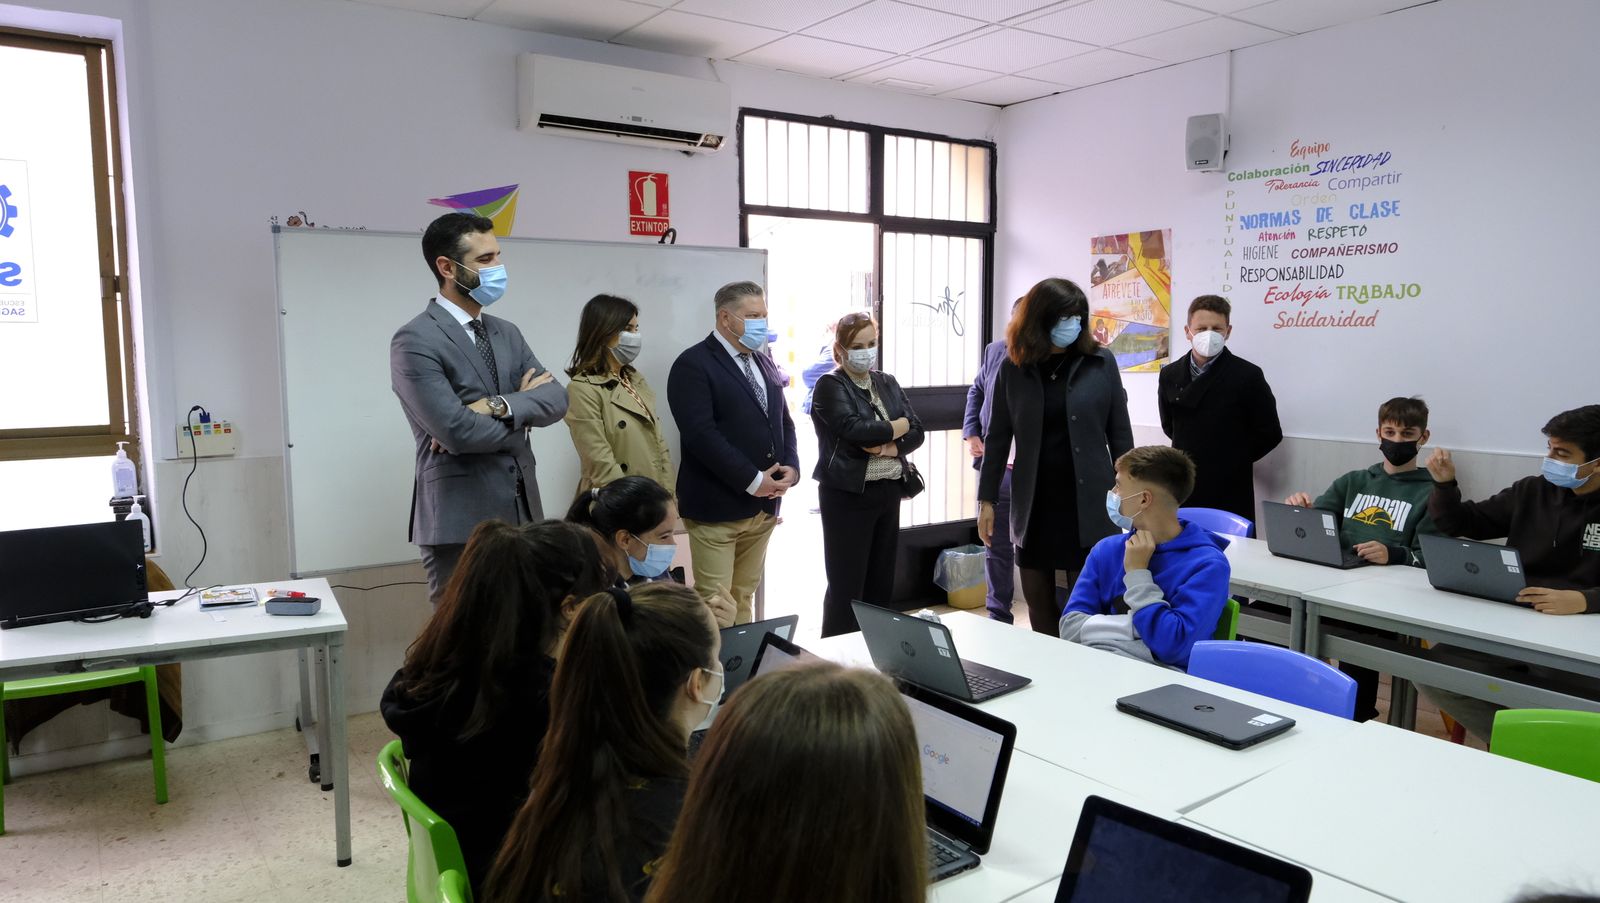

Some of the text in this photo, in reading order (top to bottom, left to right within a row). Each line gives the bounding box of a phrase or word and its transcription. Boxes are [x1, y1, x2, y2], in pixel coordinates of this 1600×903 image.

[1290, 139, 1331, 160] Equipo
[1309, 151, 1392, 174] SINCERIDAD
[1227, 163, 1310, 182] Colaboración
[1327, 171, 1402, 191] Compartir
[1264, 179, 1320, 194] Tolerancia
[1240, 200, 1401, 230] NORMAS DE CLASE
[631, 220, 669, 233] EXTINTOR
[1258, 229, 1296, 241] Atención
[1308, 224, 1368, 241] RESPETO
[1243, 245, 1279, 260] HIGIENE
[1291, 242, 1399, 259] COMPAÑERISMO
[1240, 264, 1345, 283] RESPONSABILIDAD
[1264, 283, 1422, 307] Ecología TRABAJO
[1273, 309, 1379, 329] Solidaridad
[923, 744, 950, 765] Google
